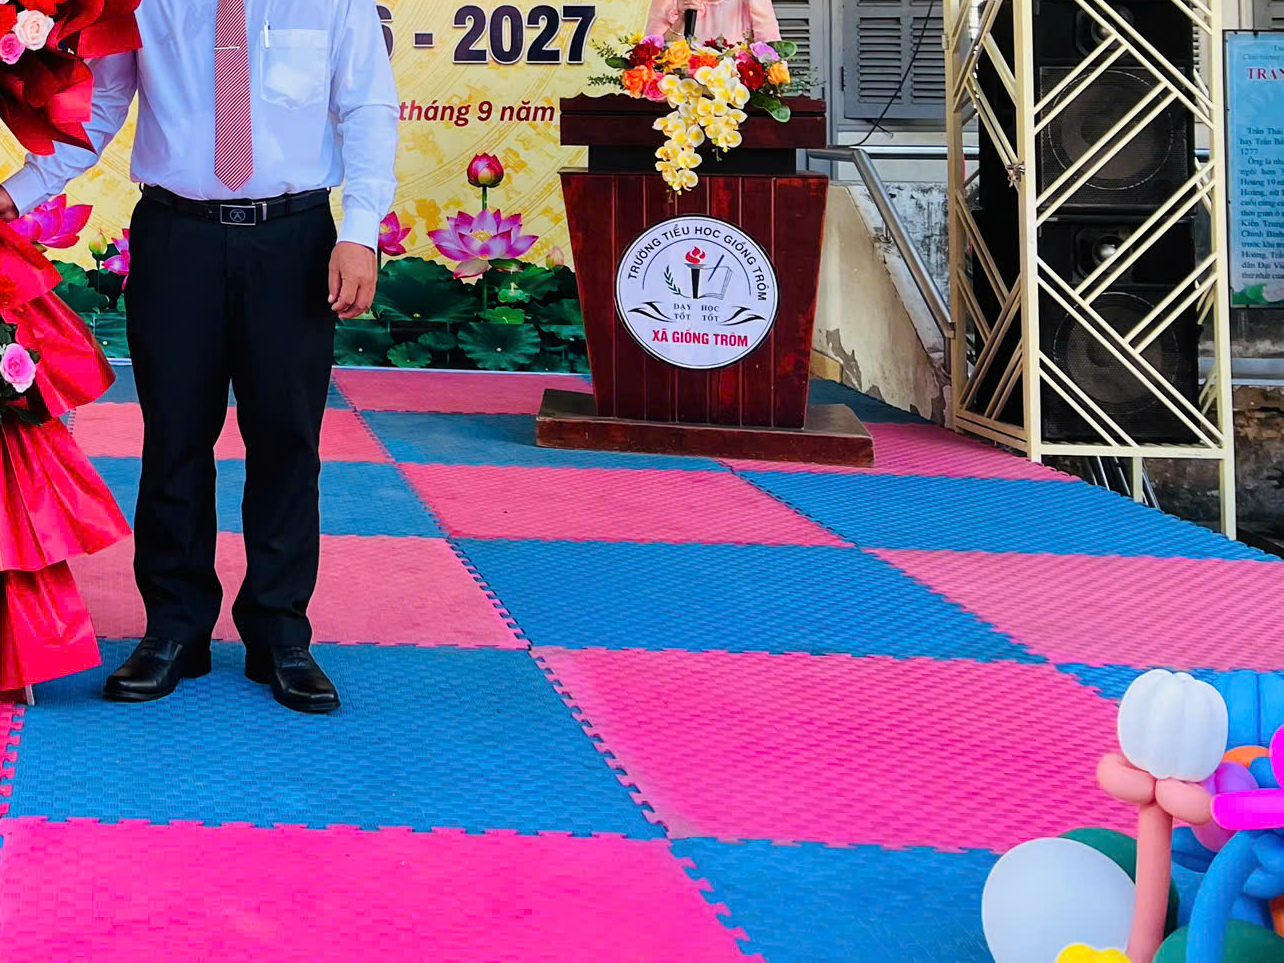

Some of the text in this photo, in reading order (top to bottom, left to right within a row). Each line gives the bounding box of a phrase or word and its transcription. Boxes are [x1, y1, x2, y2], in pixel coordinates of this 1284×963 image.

[452, 4, 597, 65] 2027
[399, 99, 555, 127] tháng 9 năm
